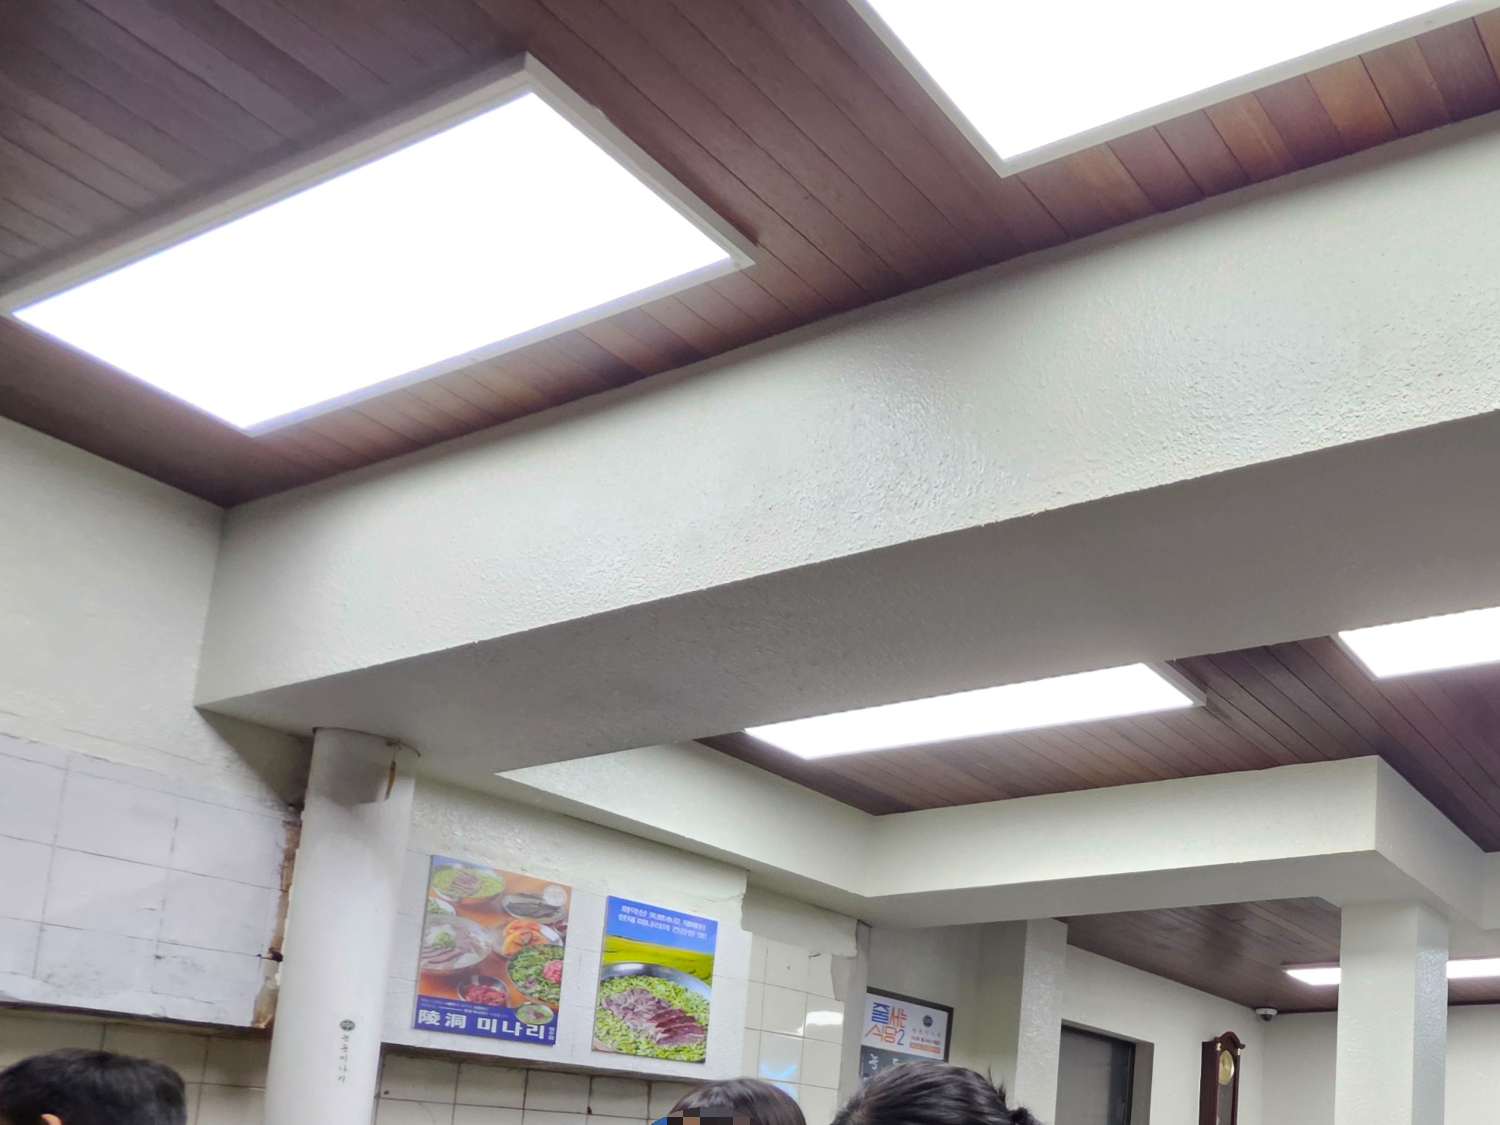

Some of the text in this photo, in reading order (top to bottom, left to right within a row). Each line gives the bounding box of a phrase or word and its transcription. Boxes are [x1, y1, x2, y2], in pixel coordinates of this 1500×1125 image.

[871, 1002, 908, 1029] 줄서는
[476, 1017, 545, 1040] 미나리
[864, 1024, 906, 1047] 식당2
